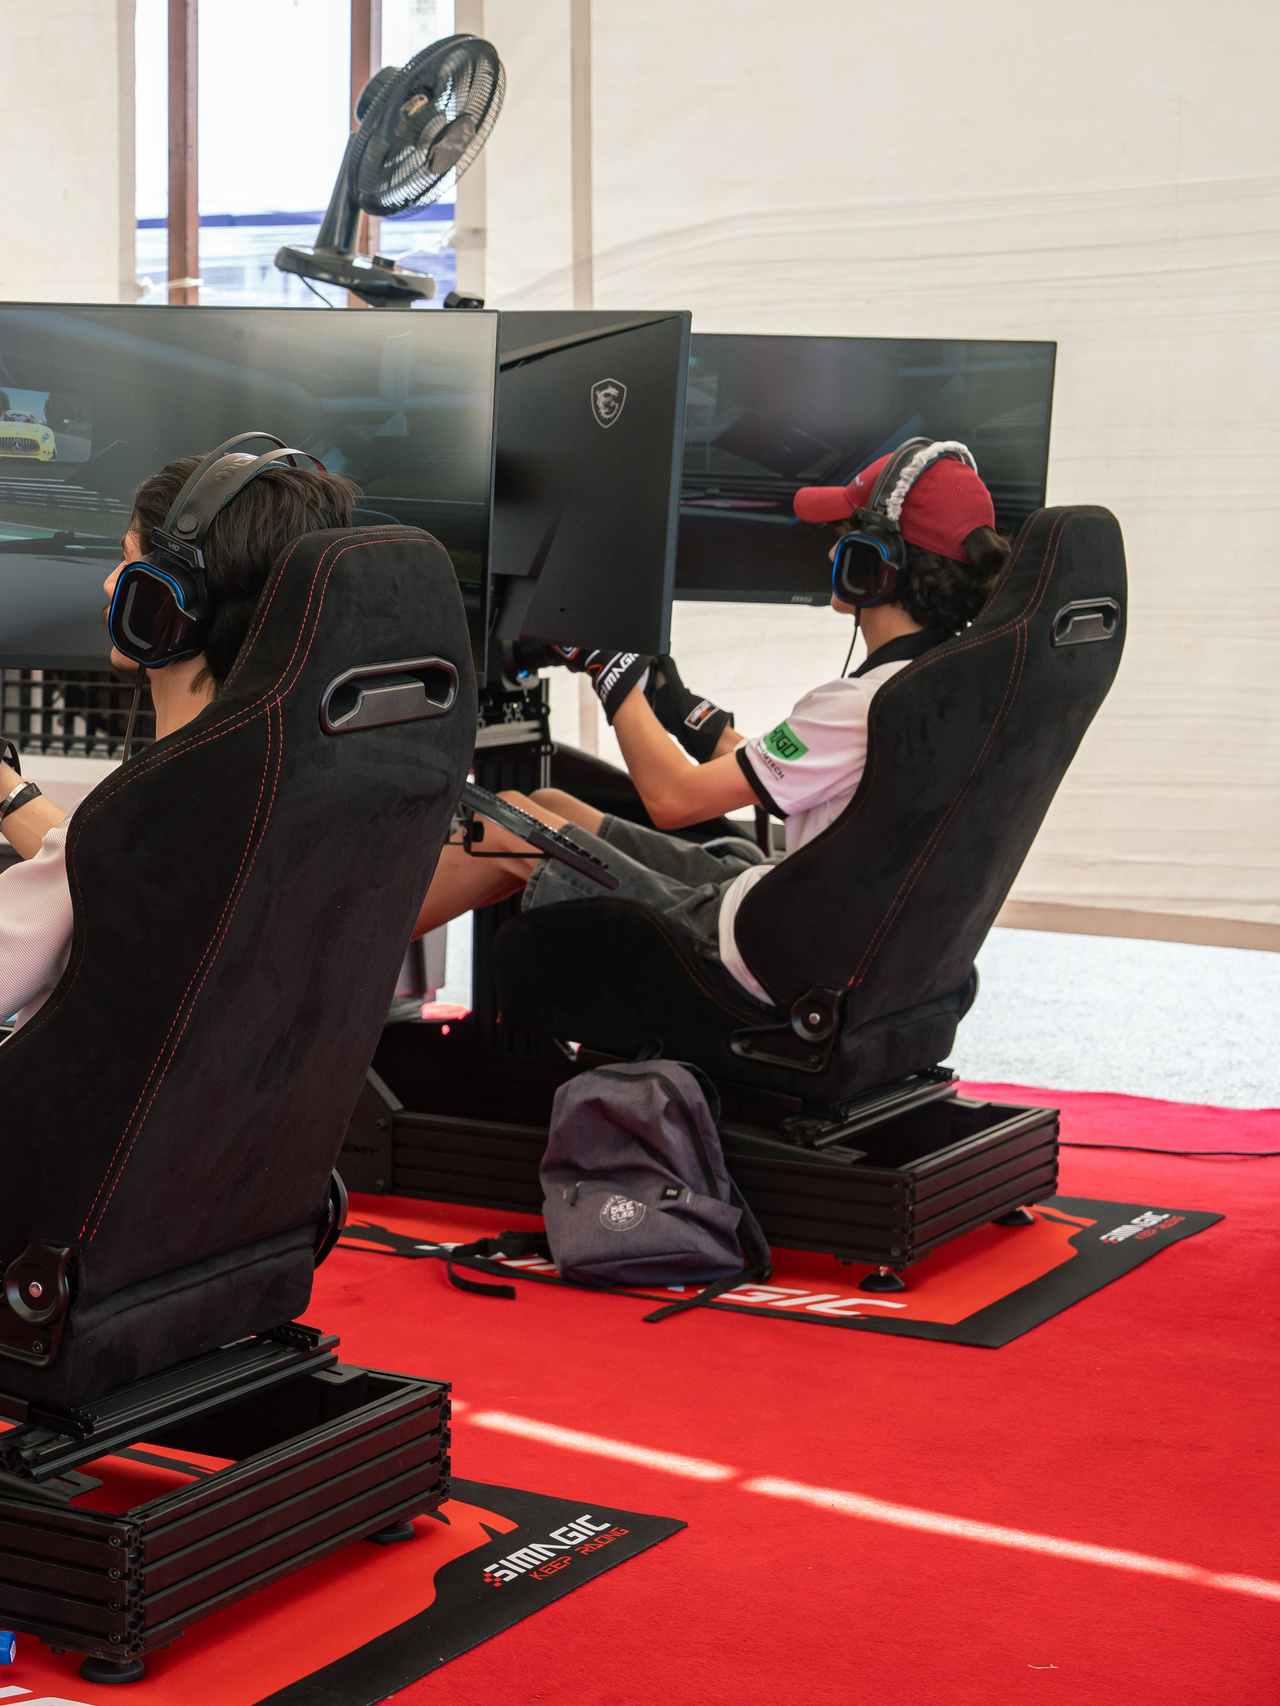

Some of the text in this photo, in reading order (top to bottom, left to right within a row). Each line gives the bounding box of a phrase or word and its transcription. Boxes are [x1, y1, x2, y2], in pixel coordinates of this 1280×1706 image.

[483, 1514, 612, 1588] SIMAGIC
[528, 1526, 630, 1581] KEEP RACING
